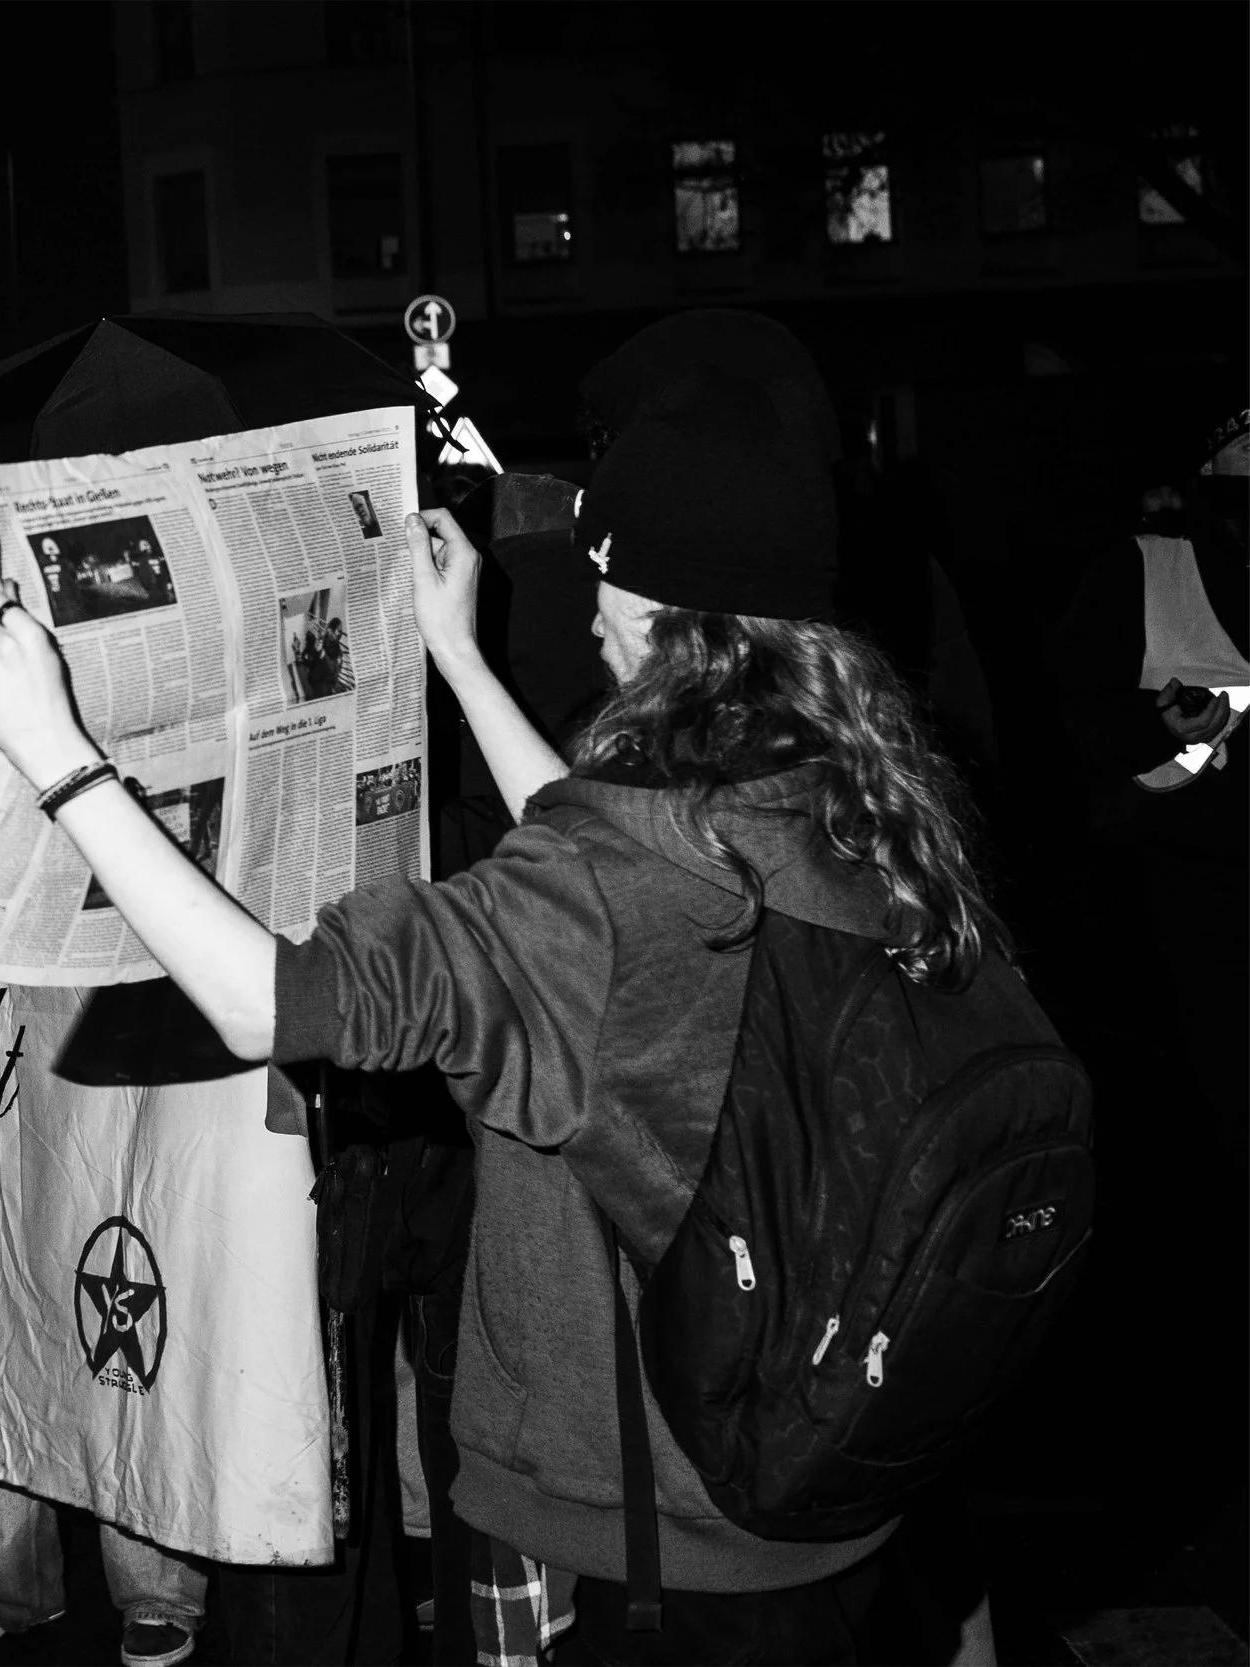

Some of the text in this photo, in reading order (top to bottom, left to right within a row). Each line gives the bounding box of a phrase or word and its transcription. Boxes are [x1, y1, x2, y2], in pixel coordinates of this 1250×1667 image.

[358, 441, 399, 455] Solidarität
[260, 462, 289, 475] wegen
[261, 729, 274, 739] dem
[276, 724, 290, 735] Weg
[101, 1283, 135, 1334] YS
